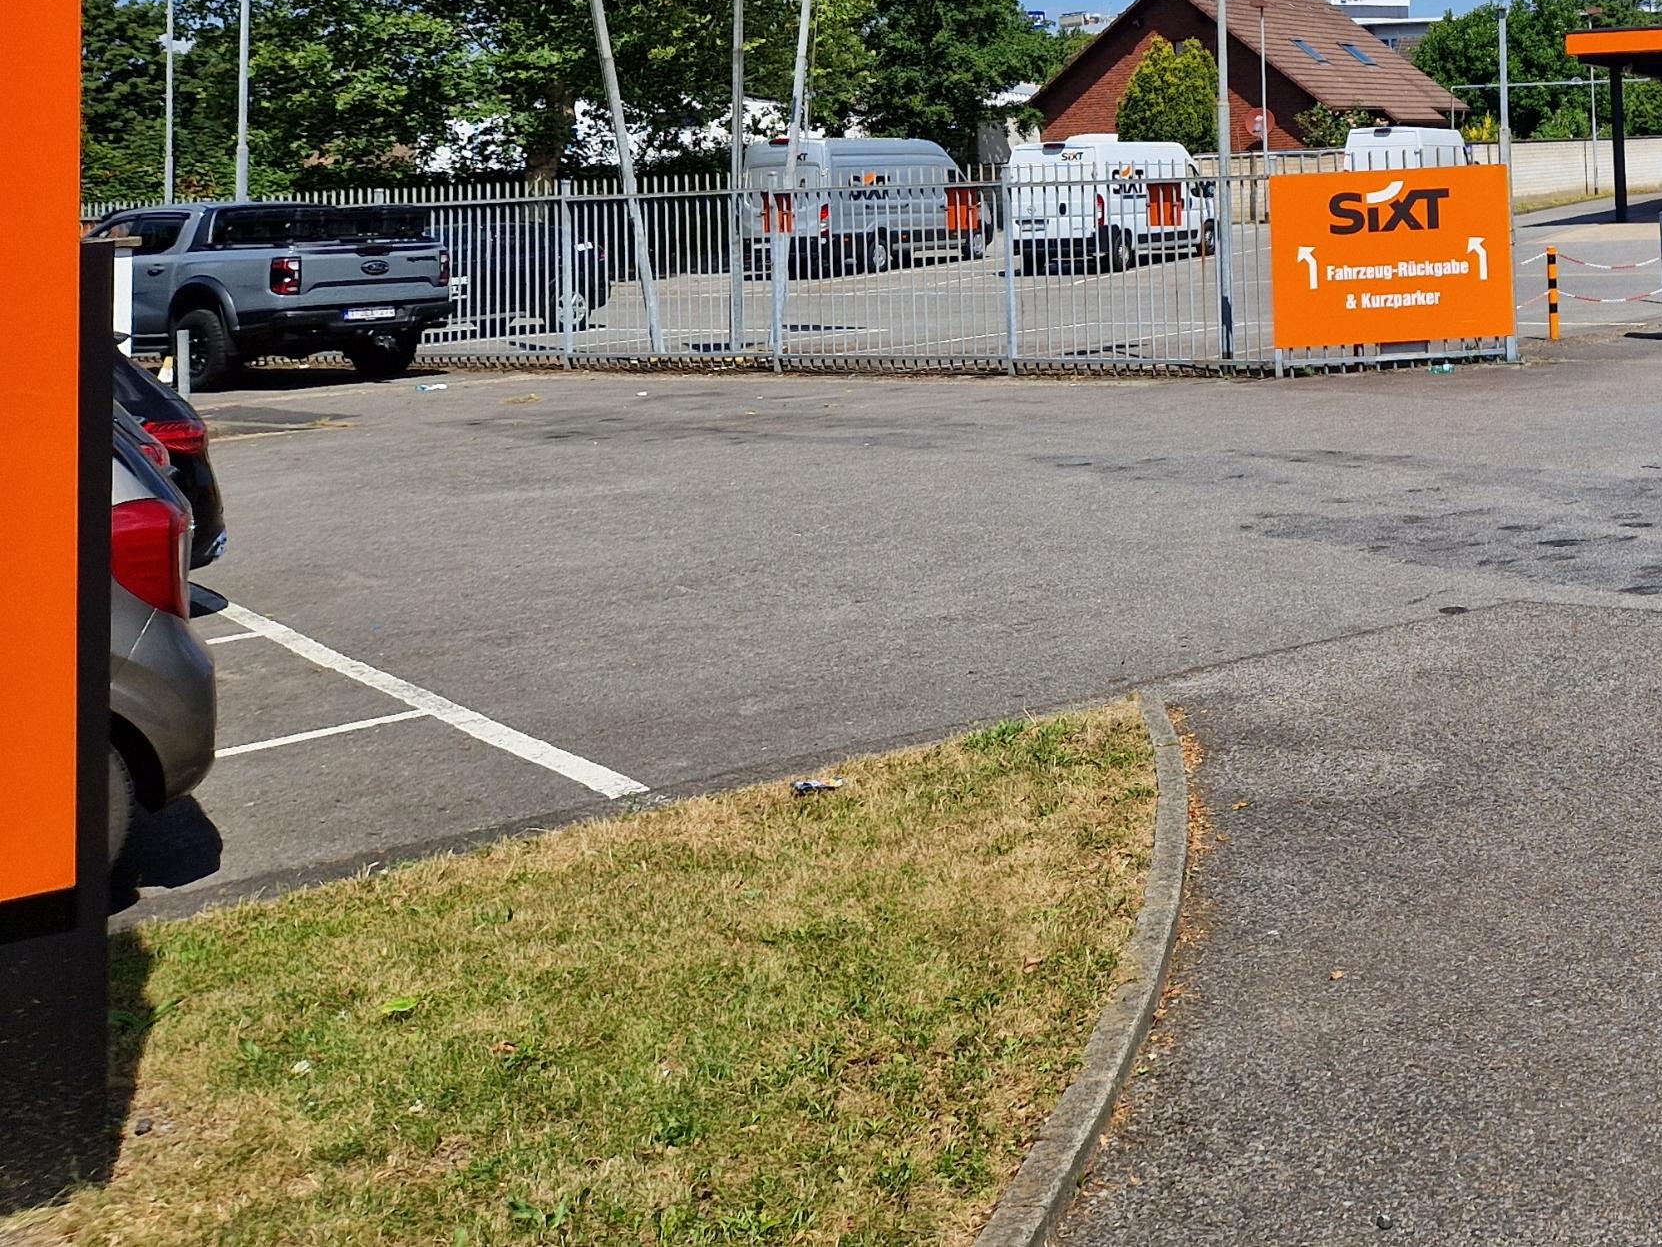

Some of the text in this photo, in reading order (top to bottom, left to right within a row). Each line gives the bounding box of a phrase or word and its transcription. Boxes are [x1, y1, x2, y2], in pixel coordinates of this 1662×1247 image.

[1327, 259, 1469, 281] Fahrzeug-Rückgabe
[1346, 290, 1440, 309] & Kurzparker
